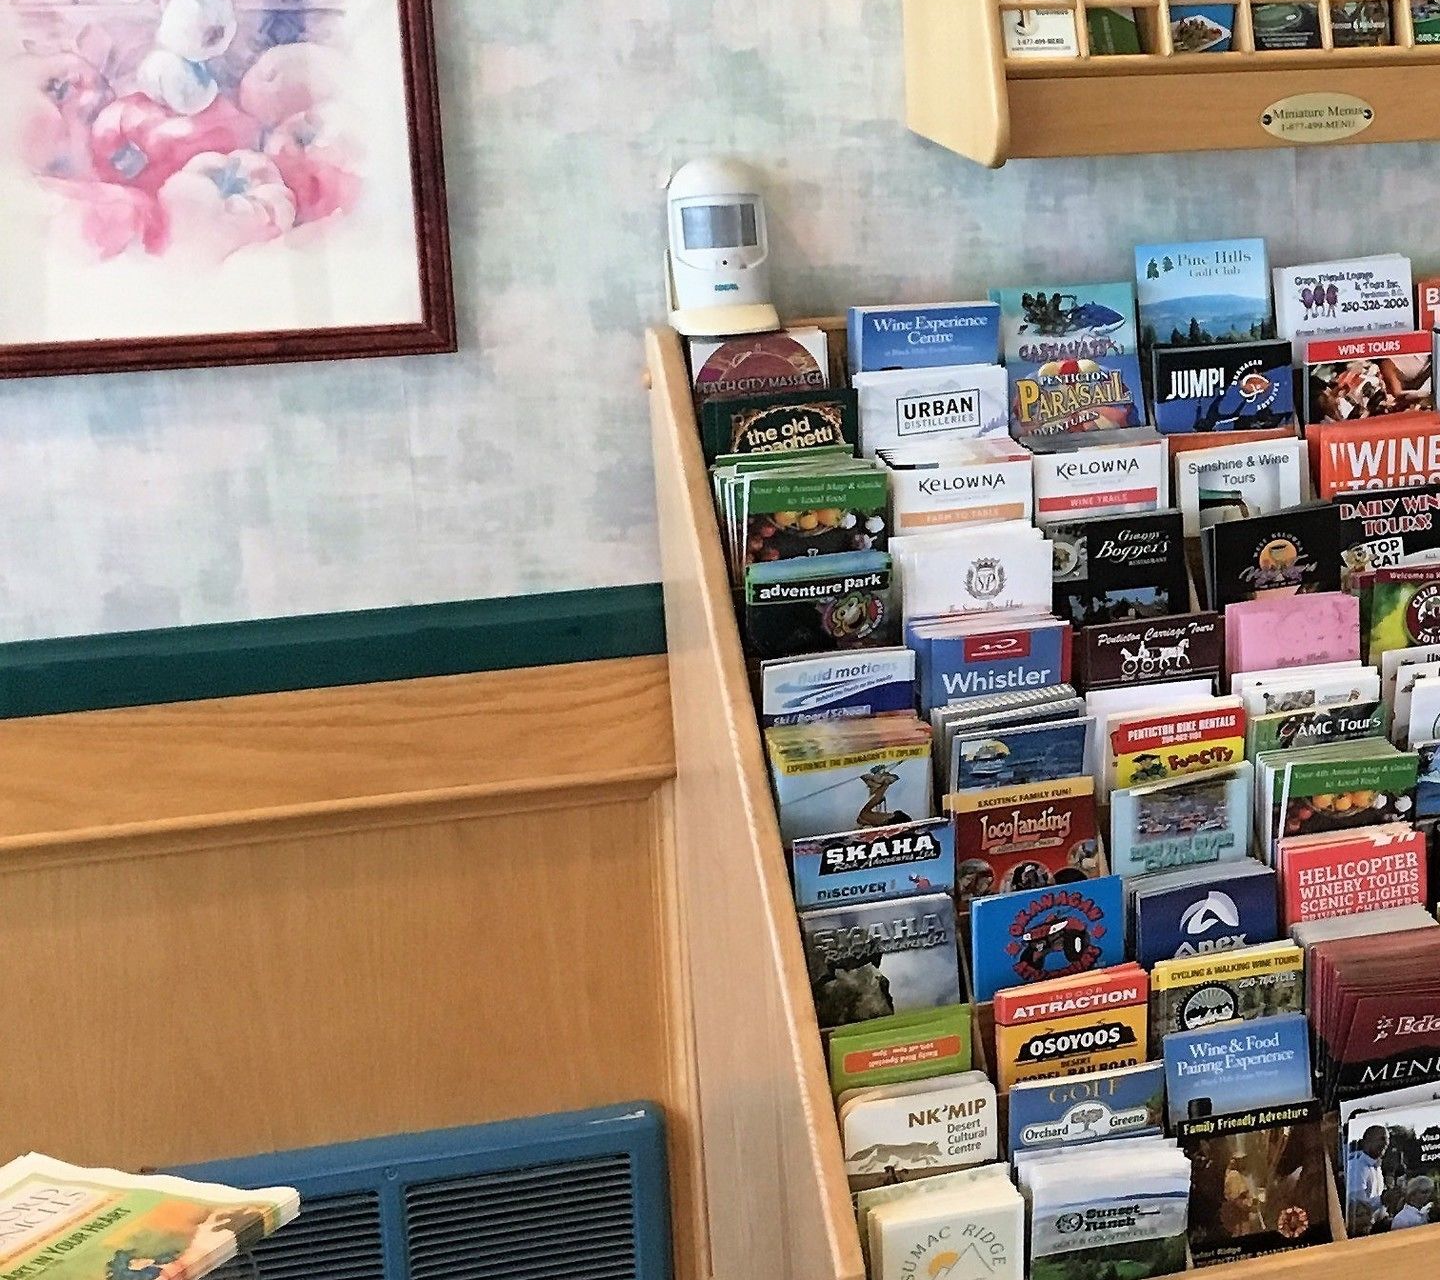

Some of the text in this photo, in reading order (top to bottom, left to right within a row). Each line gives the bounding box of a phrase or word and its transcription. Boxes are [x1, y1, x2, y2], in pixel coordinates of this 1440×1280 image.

[1273, 106, 1364, 120] Miniature Menus
[873, 314, 988, 332] Wine Experience
[907, 331, 953, 345] Centre
[1338, 340, 1401, 357] WINE TOURS
[737, 371, 824, 392] CITY MASSAGE
[1039, 371, 1110, 386] PENTICTON
[1165, 367, 1225, 401] JUMP!
[903, 396, 974, 420] URBAN
[1016, 369, 1132, 423] PARASAIL
[747, 416, 811, 446] the old
[903, 412, 976, 431] DISTILLERIES
[1187, 453, 1290, 475] Sunshine & Wine
[1222, 471, 1256, 486] Tours
[1340, 496, 1400, 521] DAILY
[1362, 513, 1433, 537] TOURS!
[1095, 538, 1172, 559] Bogner's
[1367, 539, 1400, 555] TOP
[1371, 552, 1401, 568] CAT
[1389, 570, 1424, 581] Welcome
[1425, 571, 1434, 580] to
[759, 581, 842, 600] adventure
[1412, 585, 1439, 609] CLUB
[1143, 622, 1215, 643] Carriage Tours
[941, 667, 1051, 695] Whistler
[1128, 715, 1236, 742] PENTICTON RENTALS
[1298, 717, 1382, 738] AMC Tours
[977, 786, 1073, 808] EXCITING FAMILY FUN!
[825, 834, 935, 867] SKAHA
[1298, 850, 1419, 887] HELICOPTER
[816, 881, 887, 901] DISCOVER
[1299, 869, 1419, 901] WINERY TOURS
[1300, 882, 1420, 914] SCENIC FLIGHTS
[812, 913, 946, 952] SKAHA
[1171, 954, 1300, 981] CYCLING WALKING WINE TOURS
[1012, 987, 1138, 1021] ATTRACTION
[1029, 1026, 1121, 1057] OSOYOOS
[1189, 1031, 1280, 1059] Wine & Food
[1176, 1047, 1295, 1077] Pairing Experience
[1048, 1078, 1124, 1104] GOLF
[907, 1097, 988, 1129] NK'MIP
[1183, 1106, 1309, 1137] Family Friendly Adventure
[946, 1118, 982, 1134] Desert
[946, 1126, 988, 1146] Cultural
[1023, 1111, 1146, 1140] Orchard Greens
[946, 1139, 983, 1157] Centre
[1085, 1203, 1141, 1219] Sunset
[1084, 1215, 1137, 1233] Ranch
[962, 1223, 1007, 1267] RIDGE
